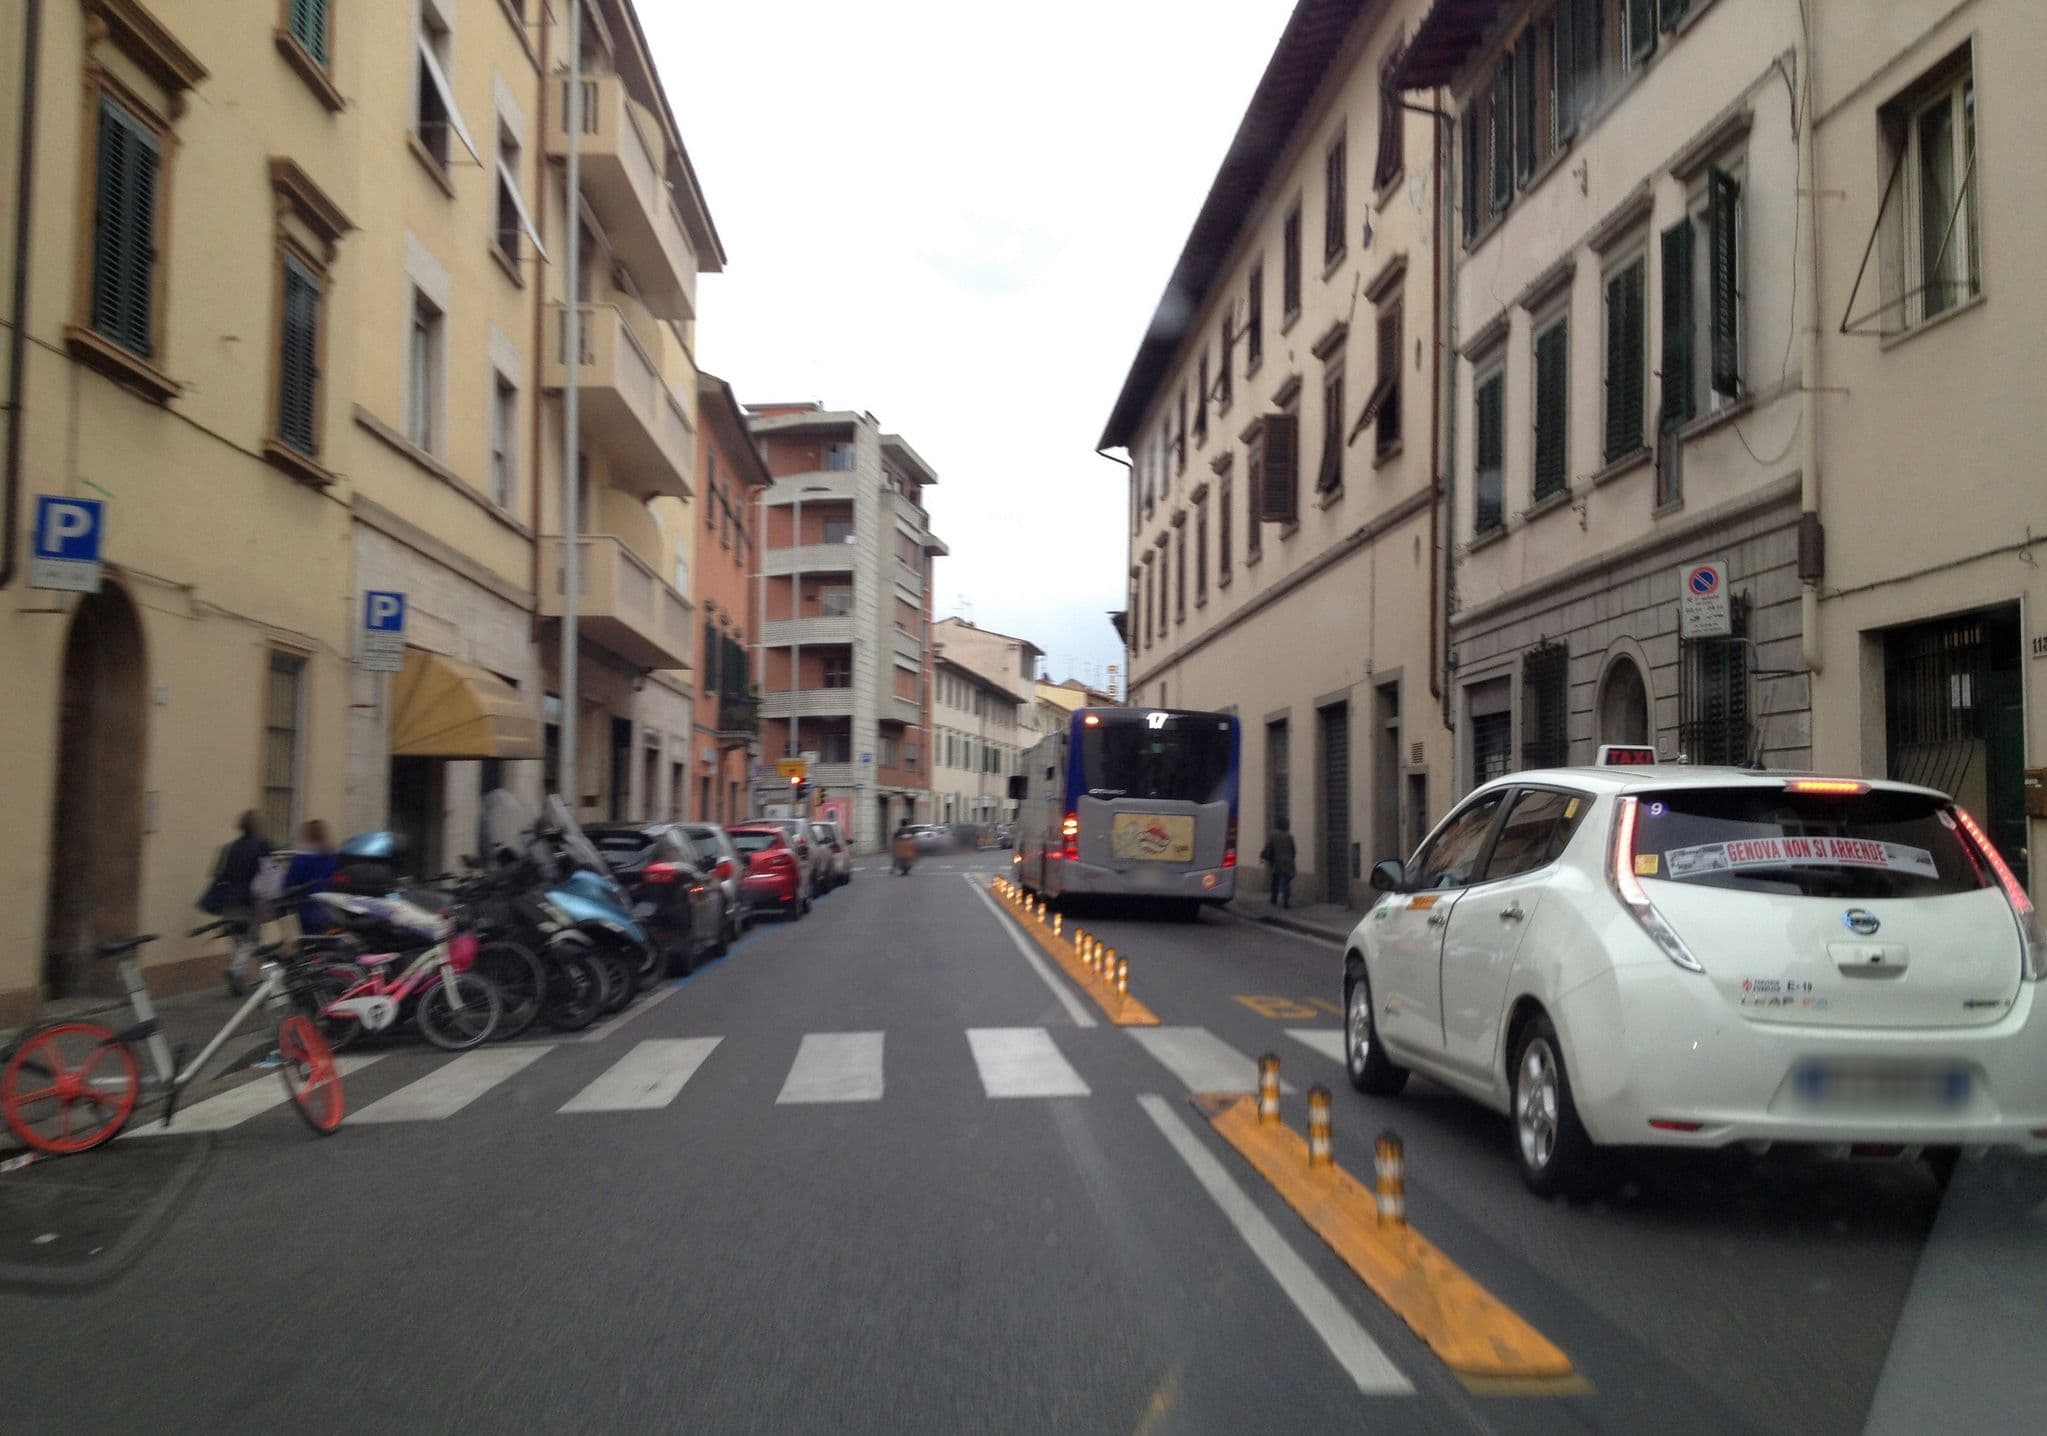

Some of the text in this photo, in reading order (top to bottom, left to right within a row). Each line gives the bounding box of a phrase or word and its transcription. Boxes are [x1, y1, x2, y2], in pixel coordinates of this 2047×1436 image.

[44, 503, 91, 552] P
[371, 596, 400, 627] P
[1146, 711, 1168, 728] 17
[1609, 751, 1652, 764] TAXI
[1651, 802, 1663, 815] 9
[1727, 838, 1887, 863] GENOVA NON SI ARRENDE
